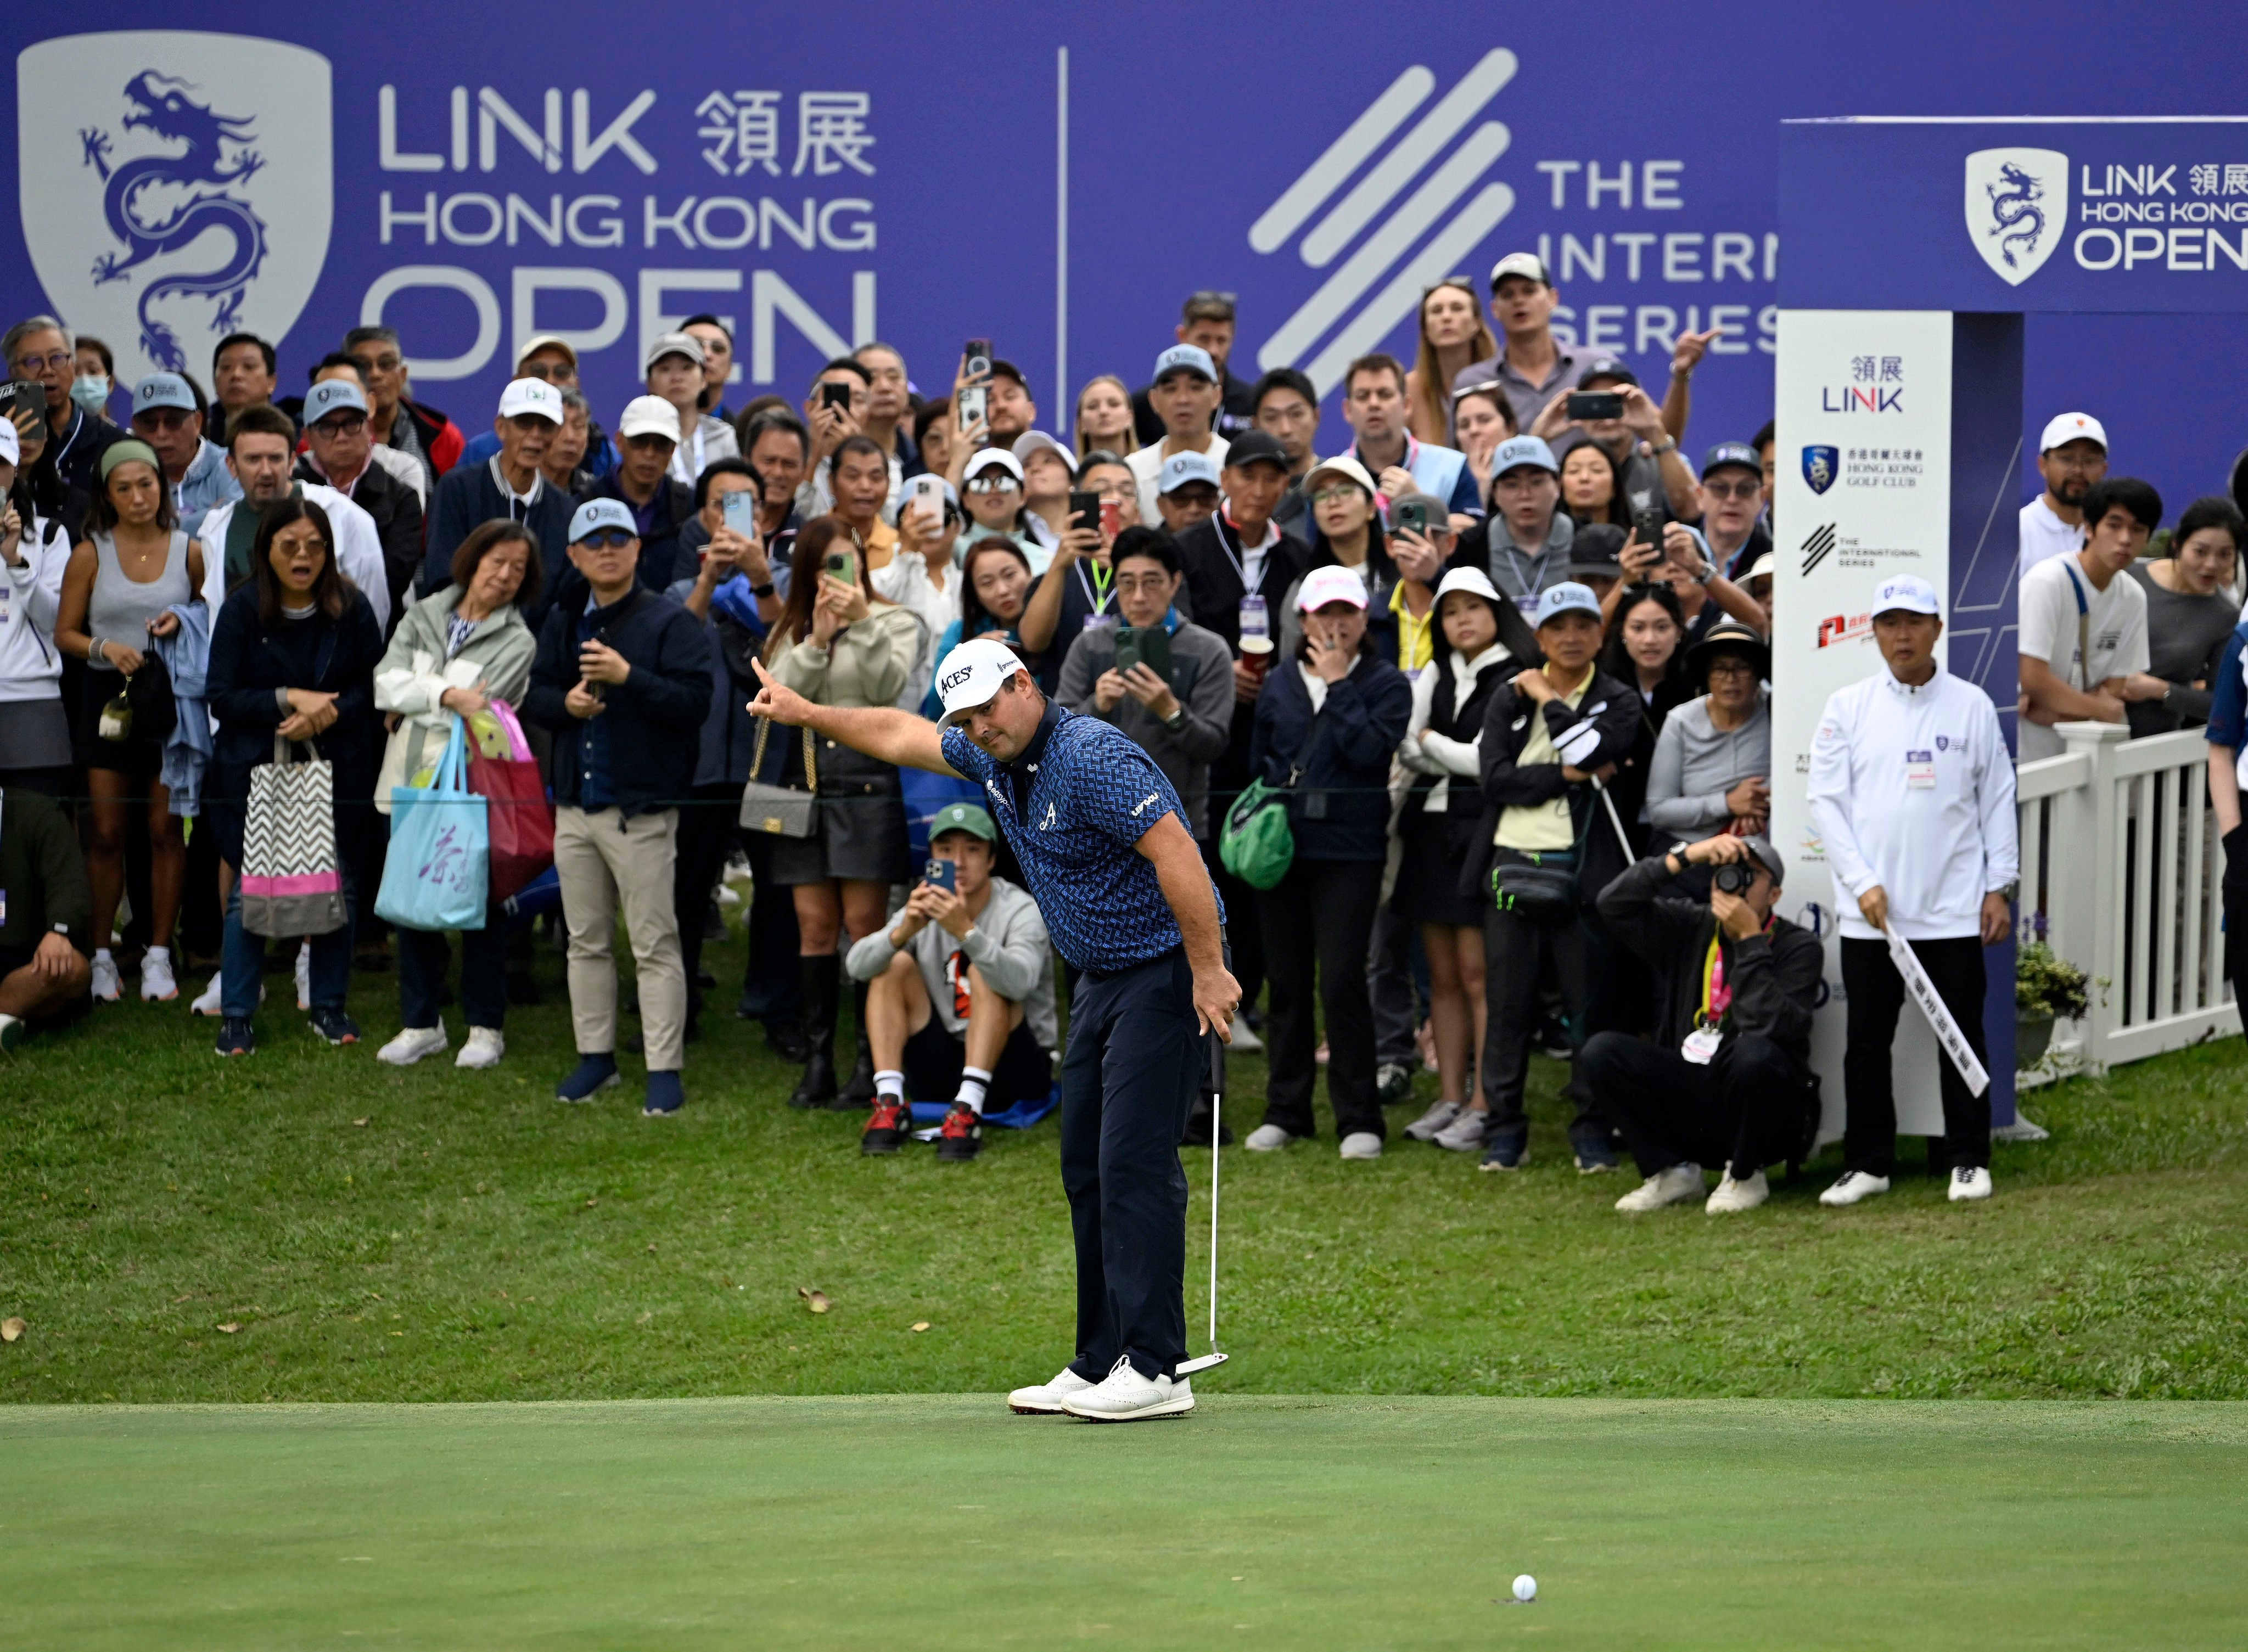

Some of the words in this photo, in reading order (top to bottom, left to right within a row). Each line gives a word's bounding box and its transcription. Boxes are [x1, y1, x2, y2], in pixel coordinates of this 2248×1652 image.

[379, 84, 658, 175] LINK
[695, 90, 876, 177] 領展
[1536, 160, 1684, 210] THE
[2082, 164, 2177, 196] LINK
[2188, 164, 2248, 196] 領展
[380, 191, 624, 248] HONG
[643, 195, 877, 251] KONG
[2081, 202, 2165, 222] HONG
[2170, 202, 2248, 222] KONG
[2073, 228, 2248, 271] OPEN
[360, 265, 877, 384] OPEN
[1851, 355, 1903, 383] 領展
[1823, 386, 1903, 413] LINK
[1847, 463, 1885, 474] HONG
[1888, 463, 1924, 474] KONG
[1847, 476, 1879, 487] GOLF
[1883, 476, 1916, 487] CLUB
[1839, 537, 1859, 546] THE
[1839, 559, 1876, 567] SERIES
[991, 786, 1015, 815] easypost
